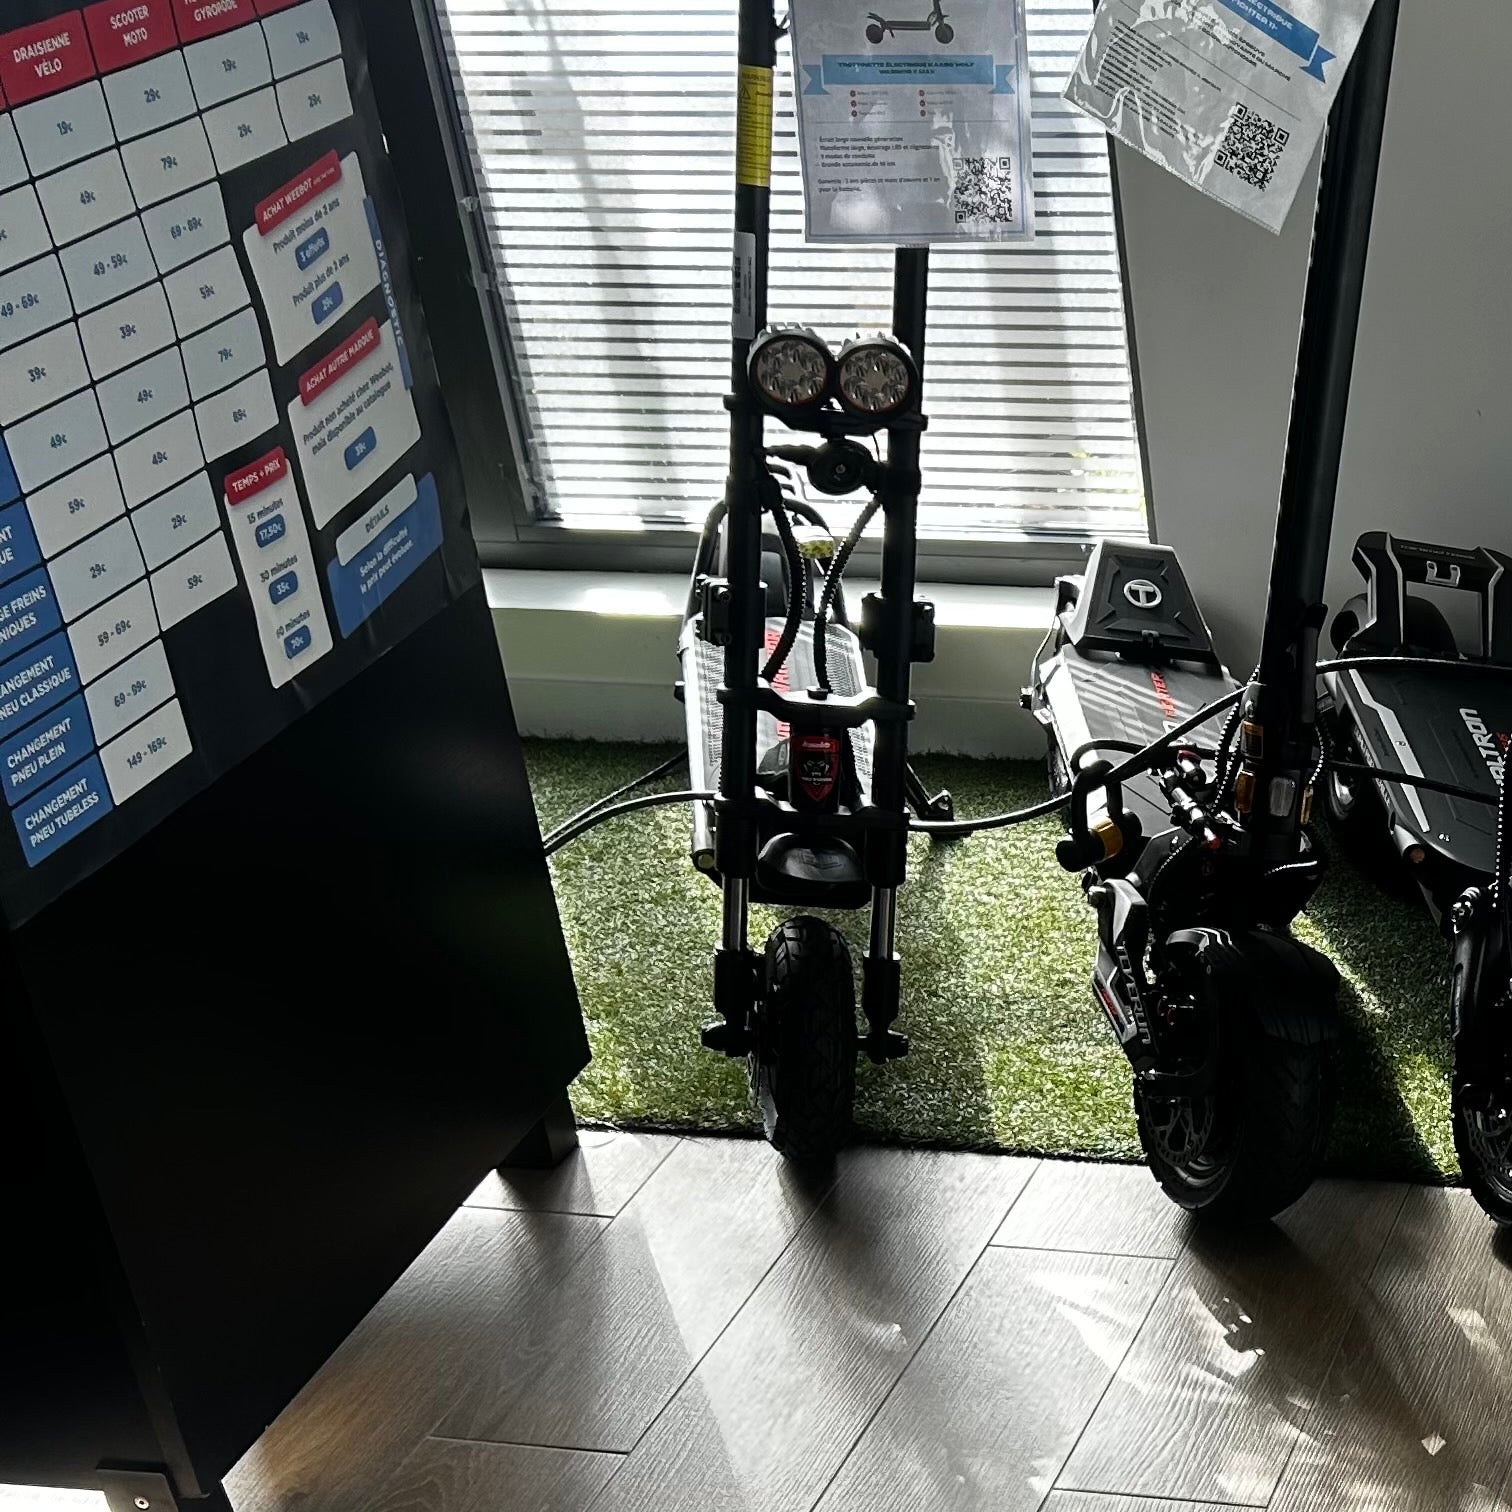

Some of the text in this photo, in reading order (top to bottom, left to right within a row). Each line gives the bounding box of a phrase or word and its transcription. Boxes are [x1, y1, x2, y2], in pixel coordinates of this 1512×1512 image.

[110, 5, 149, 30] SCOOTER
[194, 1, 238, 22] GYROPODE
[13, 32, 71, 63] DRAISIENNE
[123, 27, 148, 47] MOTO
[34, 58, 62, 78] VÉLO
[262, 177, 313, 222] ACHAT WEEBOT
[375, 239, 404, 345] DIAGNOSTIC
[306, 328, 374, 392] ACHAT AUTRE MARQUE
[232, 472, 260, 493] TEMPS
[264, 458, 281, 474] PRIX
[246, 498, 284, 525] 15 minutes
[365, 504, 390, 534] DÉTAILS
[270, 554, 298, 577] minutes
[359, 558, 376, 577] Selon
[11, 585, 47, 616] FREINS
[0, 611, 37, 644] NIQUES
[285, 609, 311, 633] minutes
[0, 655, 54, 698] ANGEMENT
[0, 667, 72, 721] NEU CLASSIQUE
[7, 717, 73, 769] CHANGEMENT
[11, 741, 66, 787] PNEU PLEIN
[25, 777, 89, 831] CHANGEMENT
[30, 791, 100, 848] PNEU TUBELESS
